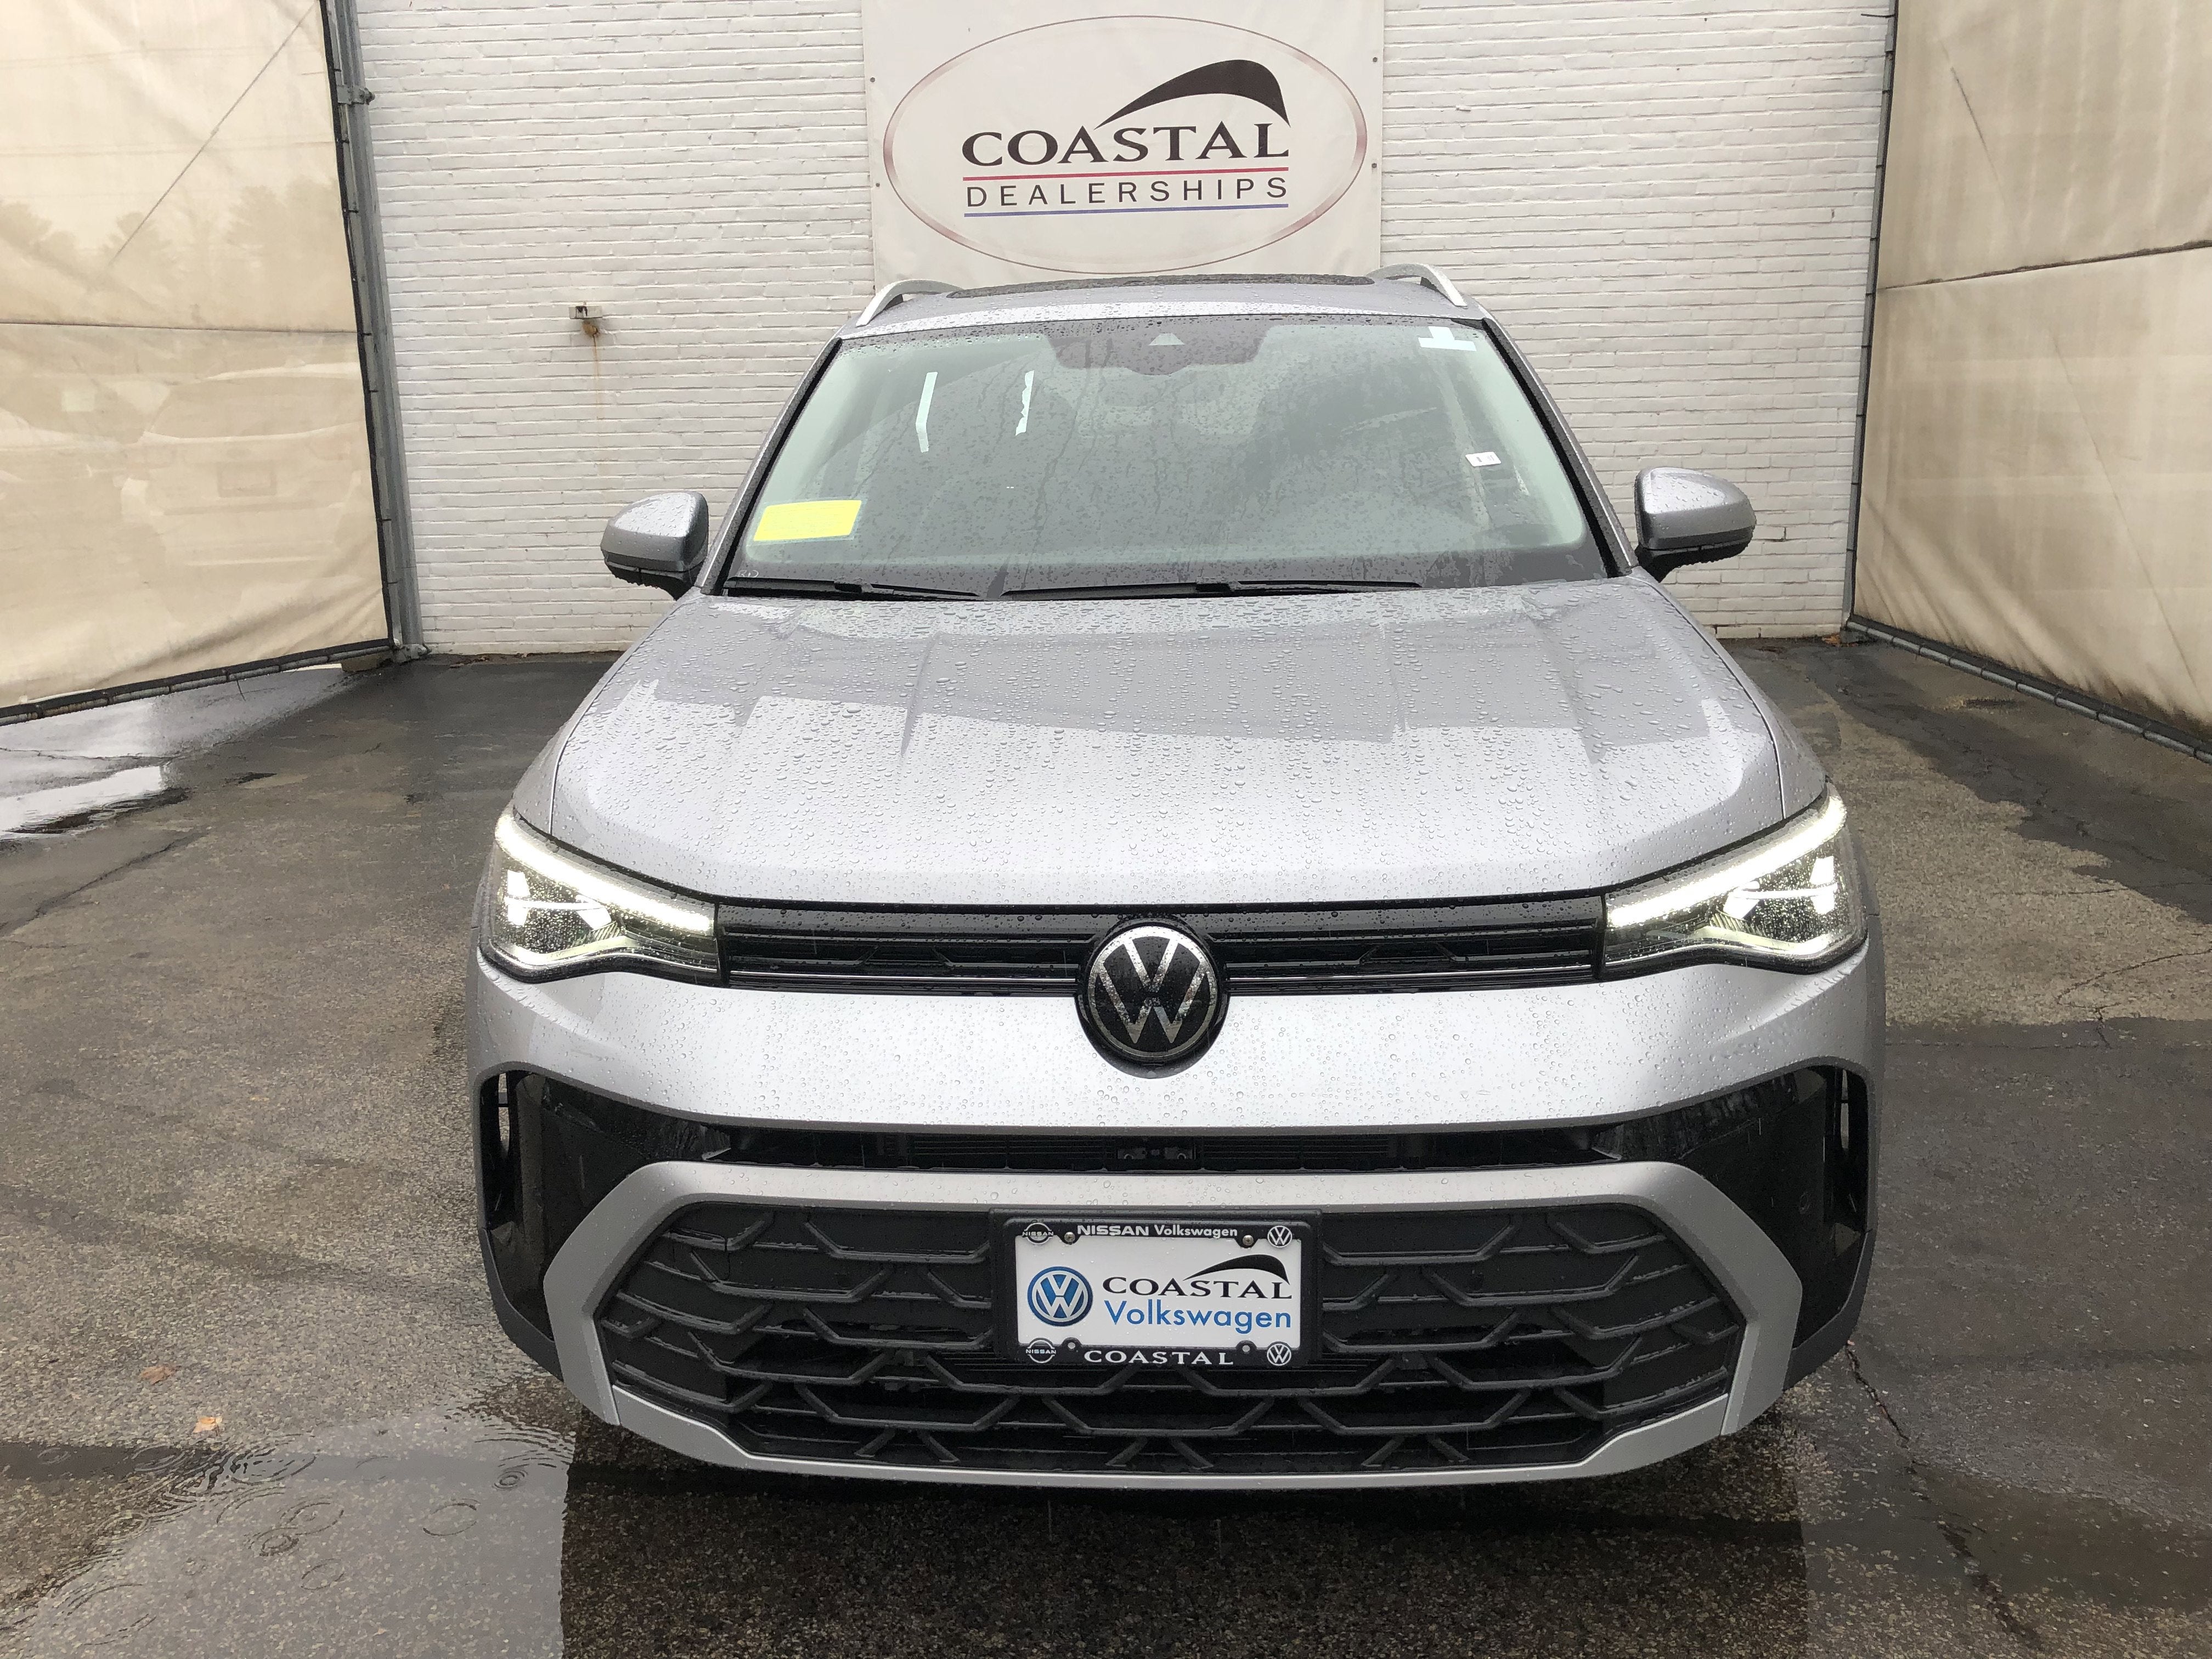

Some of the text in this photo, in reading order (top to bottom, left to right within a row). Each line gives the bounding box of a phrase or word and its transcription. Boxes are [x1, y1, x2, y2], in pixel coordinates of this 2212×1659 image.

[962, 121, 1289, 167] COASTAL
[967, 177, 1288, 207] DEALERSHIPS
[1077, 1224, 1238, 1239] NISSAN Volkswagen
[1103, 1276, 1291, 1299] COASTAL
[1104, 1299, 1291, 1334] Volkswagen
[1084, 1350, 1233, 1365] COASTAL
